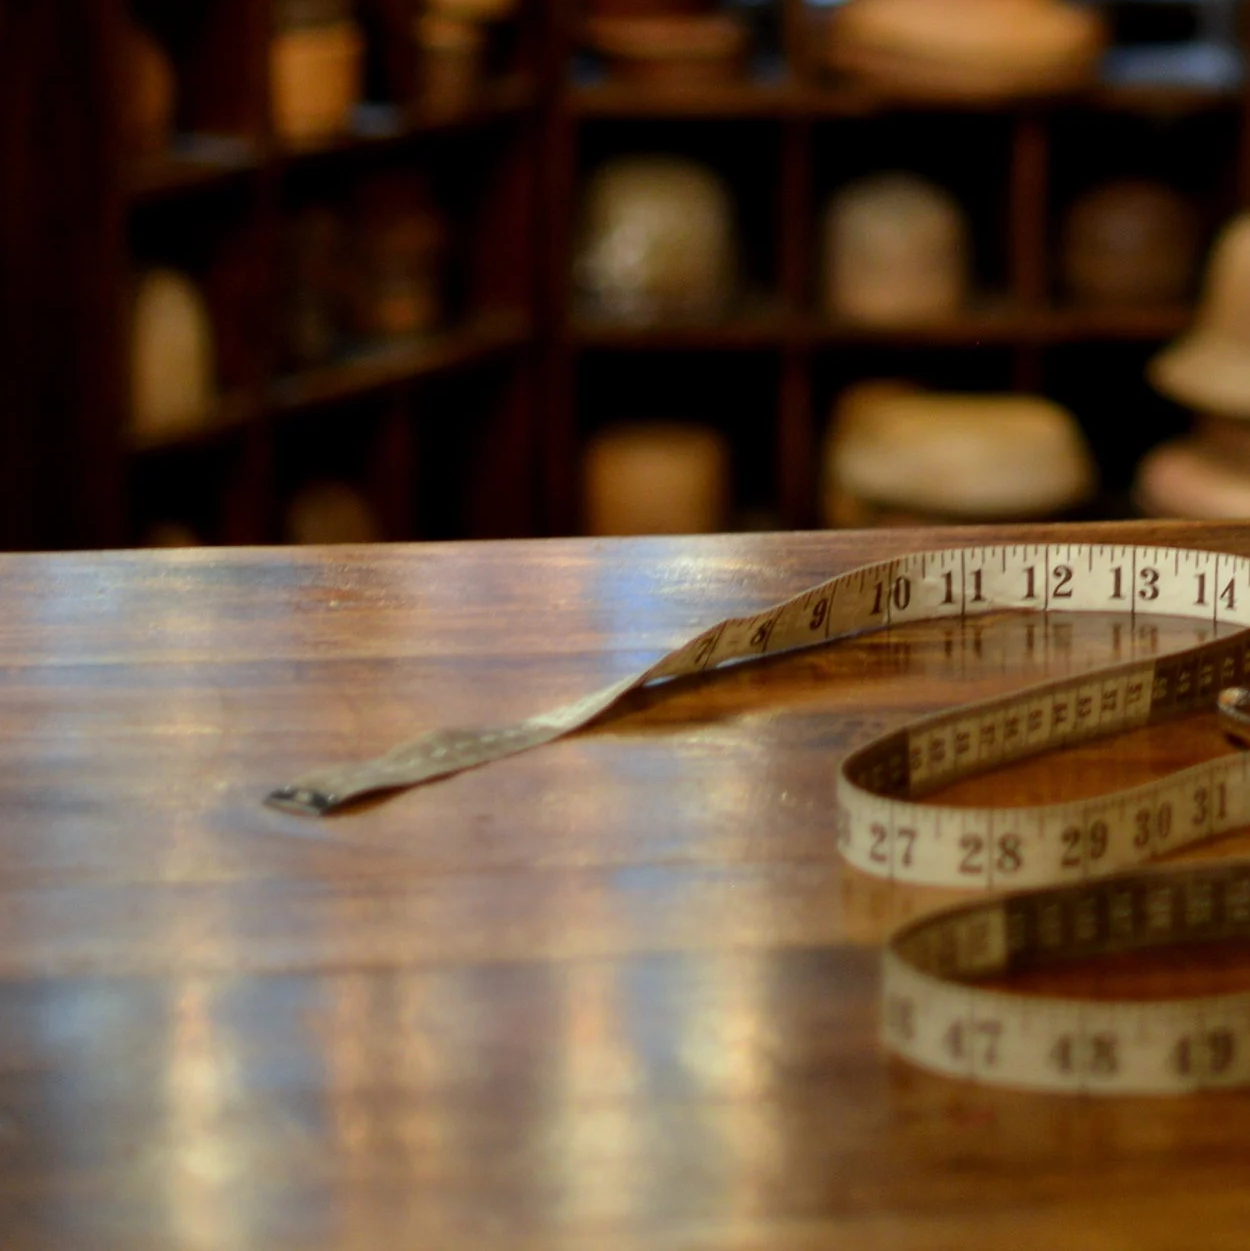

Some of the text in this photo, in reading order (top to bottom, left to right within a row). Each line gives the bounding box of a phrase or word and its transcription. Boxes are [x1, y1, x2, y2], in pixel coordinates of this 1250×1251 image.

[809, 597, 828, 630] 9
[868, 575, 911, 616] 10
[939, 568, 985, 605] 11
[1022, 564, 1073, 600] 12
[1108, 565, 1160, 600] 13
[1193, 572, 1237, 612] 14
[867, 820, 918, 867] 27
[958, 832, 1024, 876] 28
[1060, 817, 1109, 869] 29
[1132, 799, 1173, 848] 30
[1191, 784, 1228, 826] 31
